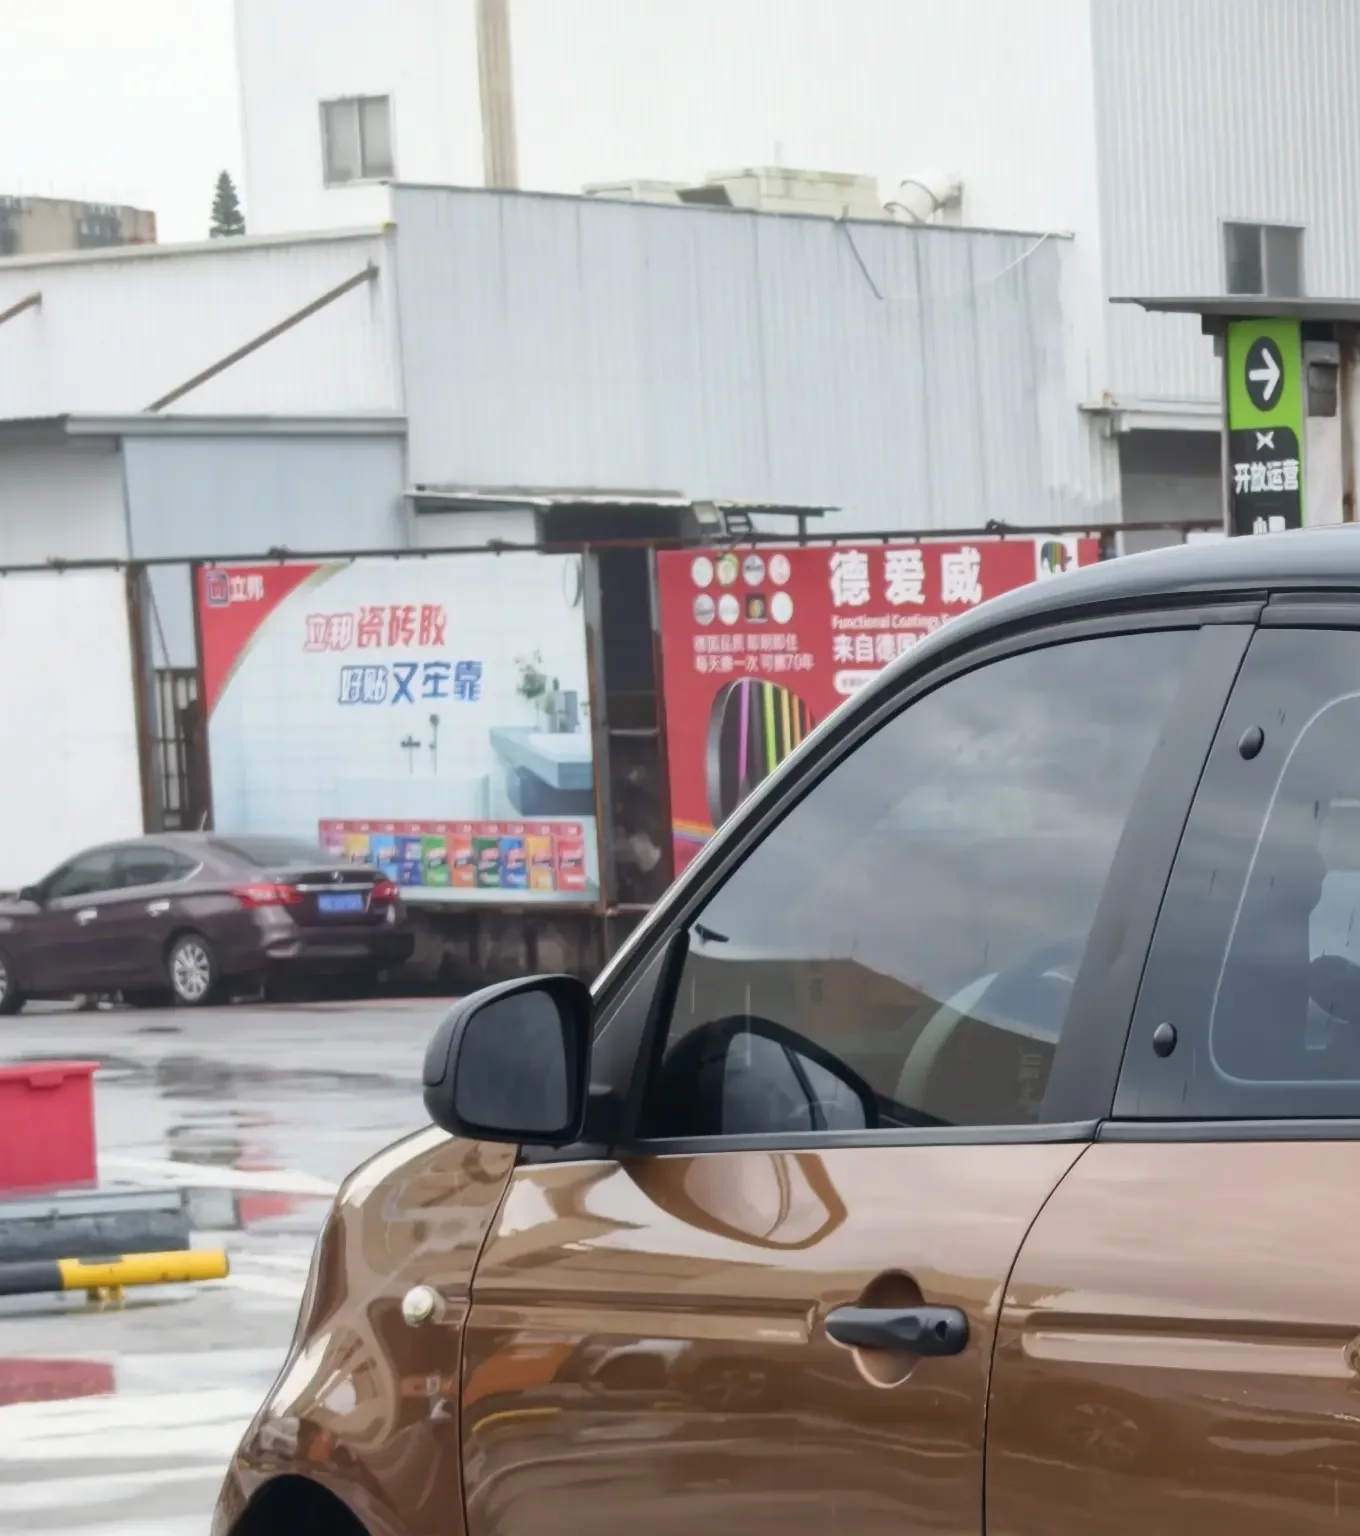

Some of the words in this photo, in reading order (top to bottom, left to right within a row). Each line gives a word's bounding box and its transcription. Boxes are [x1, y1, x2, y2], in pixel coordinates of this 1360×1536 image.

[1234, 459, 1299, 494] 开放运营
[829, 546, 984, 608] 德爱威
